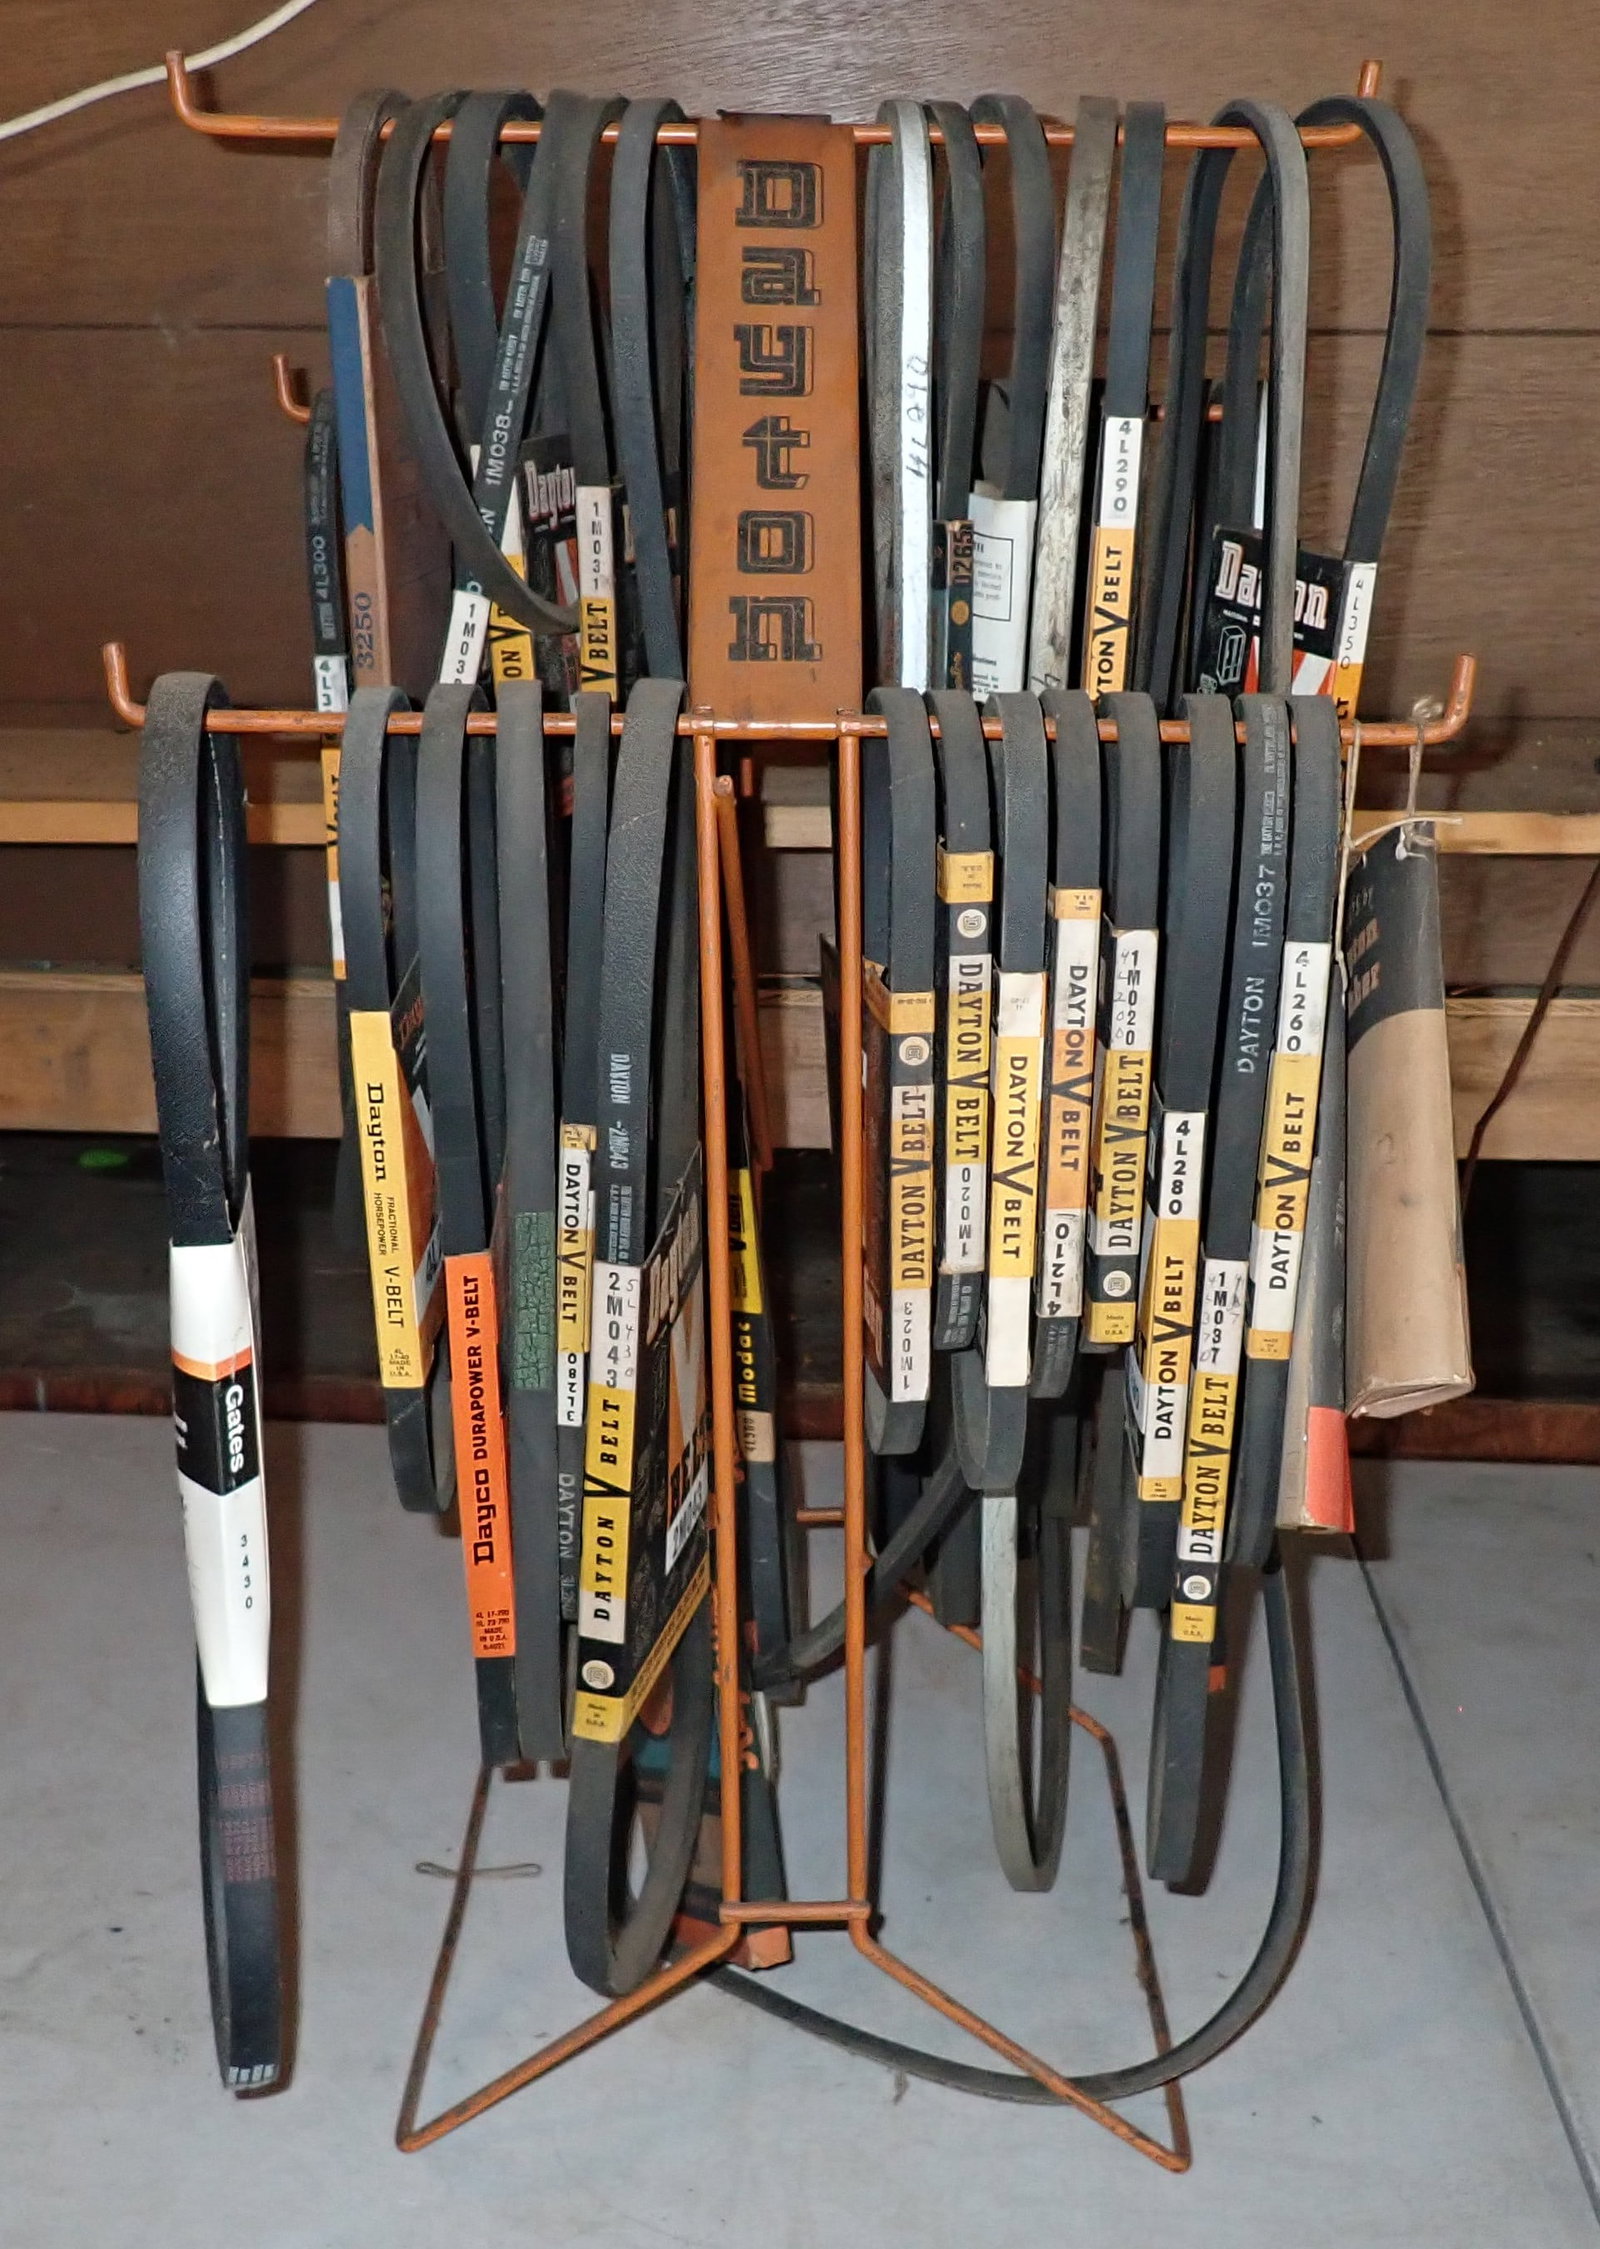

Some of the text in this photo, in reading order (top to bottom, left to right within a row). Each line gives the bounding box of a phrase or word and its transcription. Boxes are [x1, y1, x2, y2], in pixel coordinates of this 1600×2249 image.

[728, 158, 824, 662] Dayton
[1113, 420, 1132, 512] 4L290
[312, 535, 329, 600] 4L300
[590, 501, 603, 592] 1M031
[1103, 545, 1123, 602] BELT
[354, 591, 373, 671] 3250
[586, 602, 608, 661] BELT
[957, 963, 983, 1064] DAYTON
[1064, 964, 1088, 1068] DAYTON
[1125, 949, 1140, 1046] 1M020
[1238, 976, 1266, 1074] DAYTON
[1286, 951, 1310, 1053] 4L260
[609, 1053, 633, 1105] DAYTON
[901, 1090, 927, 1153] BELT
[1007, 1055, 1028, 1158] DAYTON
[1117, 1055, 1145, 1120] BELT
[1282, 1092, 1305, 1153] BELT
[366, 1082, 388, 1182] Dayton
[955, 1098, 980, 1158] BELT
[1060, 1109, 1081, 1172] BELT
[1169, 1120, 1190, 1216] 4L280
[373, 1191, 387, 1256] HORSEPOWER
[386, 1196, 400, 1254] FRACTIONAL
[564, 1163, 581, 1243] DAYTON
[901, 1184, 926, 1281] DAYTON
[957, 1166, 972, 1260] 1M020
[1002, 1199, 1022, 1259] BELT
[1110, 1151, 1138, 1249] DAYTON
[1269, 1194, 1296, 1290] DAYTON
[383, 1265, 405, 1328] V-BELT
[562, 1276, 578, 1324] BELT
[1047, 1222, 1070, 1317] 4L210
[1163, 1255, 1185, 1312] BELT
[605, 1271, 623, 1390] 2M043
[737, 1321, 757, 1403] Modac
[900, 1301, 914, 1391] 1M023
[1211, 1271, 1228, 1364] 1M037
[225, 1384, 245, 1474] Gates
[463, 1275, 497, 1567] Dayco DURAPOWER V-BELT
[566, 1353, 578, 1422] 3L280
[600, 1398, 620, 1466] BELT
[1154, 1350, 1179, 1440] DAYTON
[1201, 1376, 1229, 1437] BELT
[557, 1472, 576, 1559] DAYTON
[1189, 1465, 1221, 1556] DAYTON
[239, 1533, 253, 1610] 3430
[593, 1516, 615, 1622] DAYTON
